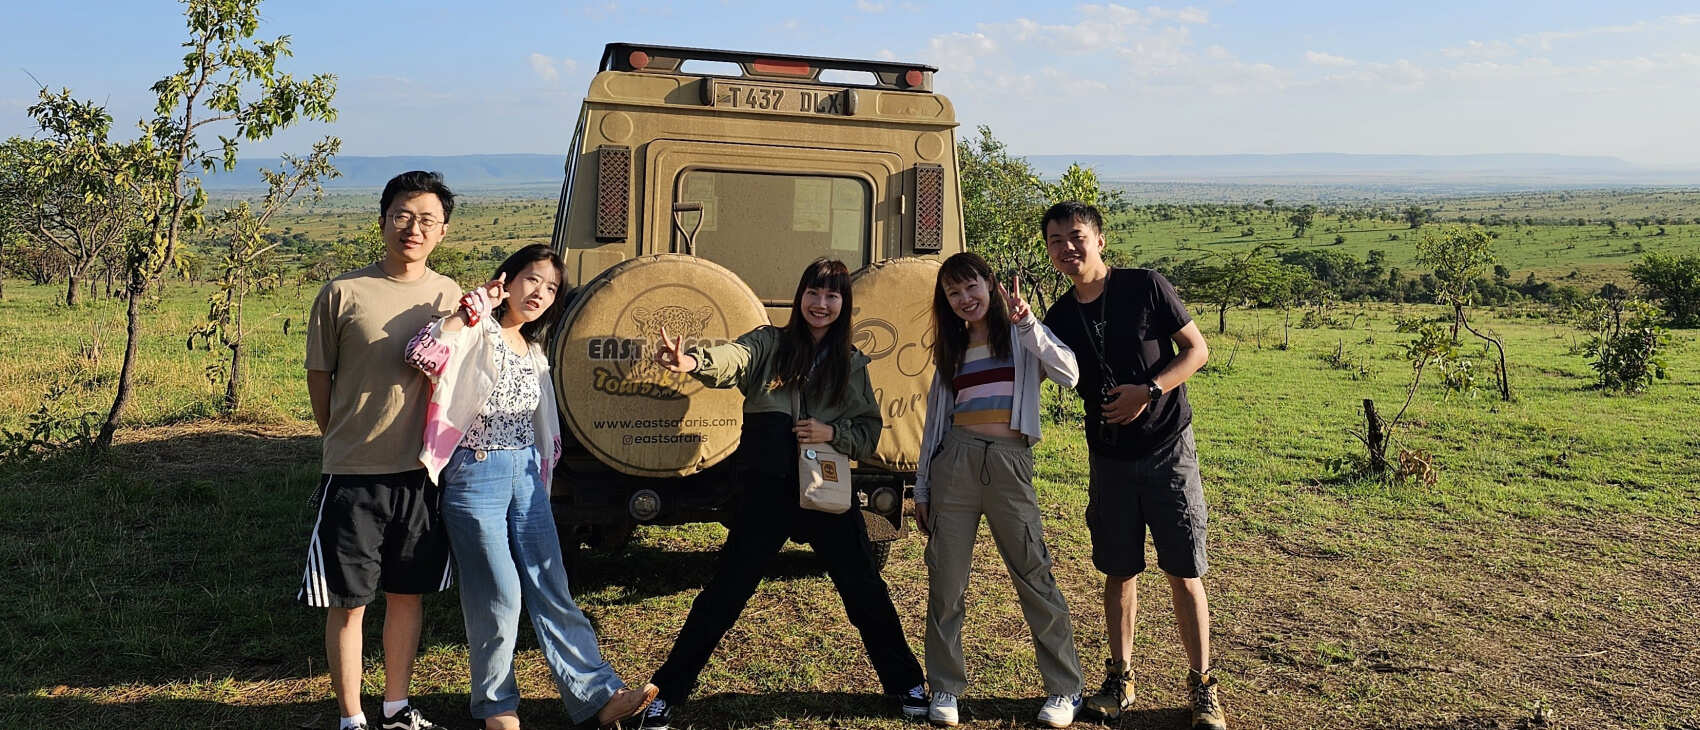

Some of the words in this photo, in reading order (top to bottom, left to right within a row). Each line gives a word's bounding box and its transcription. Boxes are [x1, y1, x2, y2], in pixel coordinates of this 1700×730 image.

[729, 87, 741, 107] T
[746, 88, 784, 111] 437
[800, 91, 839, 114] DLX
[588, 339, 646, 360] EAST
[594, 417, 737, 429] www.eastsafaris.com
